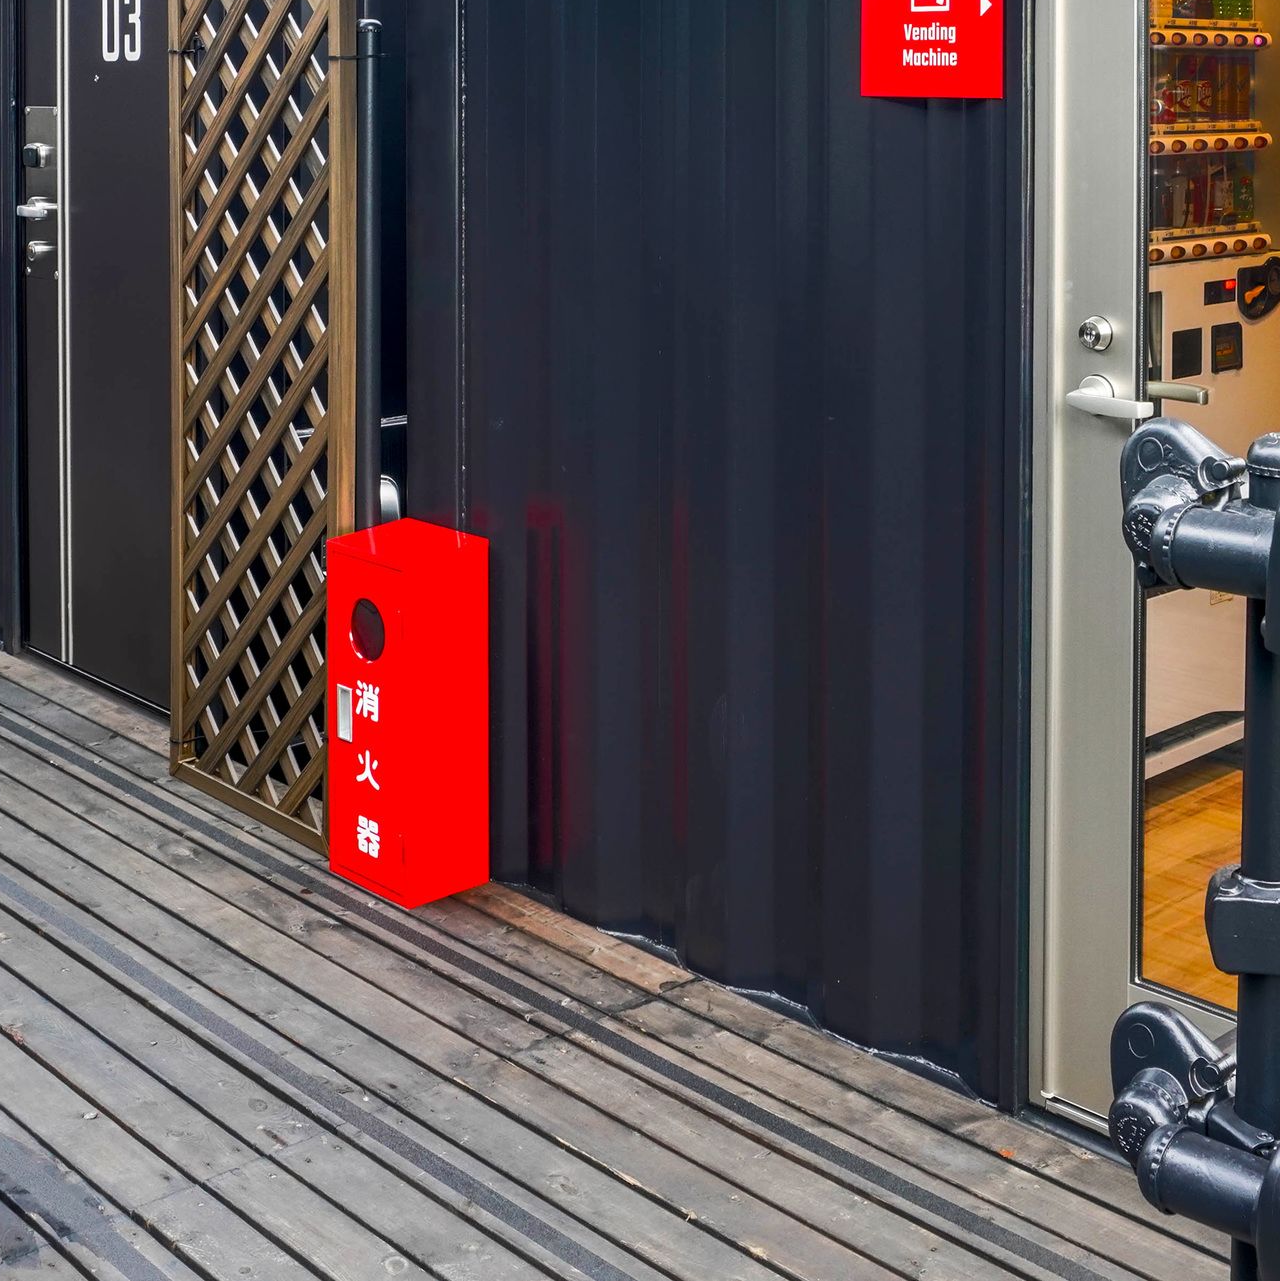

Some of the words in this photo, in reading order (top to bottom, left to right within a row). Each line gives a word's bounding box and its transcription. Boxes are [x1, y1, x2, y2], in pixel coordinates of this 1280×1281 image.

[904, 22, 957, 44] Vending
[902, 48, 958, 67] Machine
[355, 679, 381, 859] 消火器
